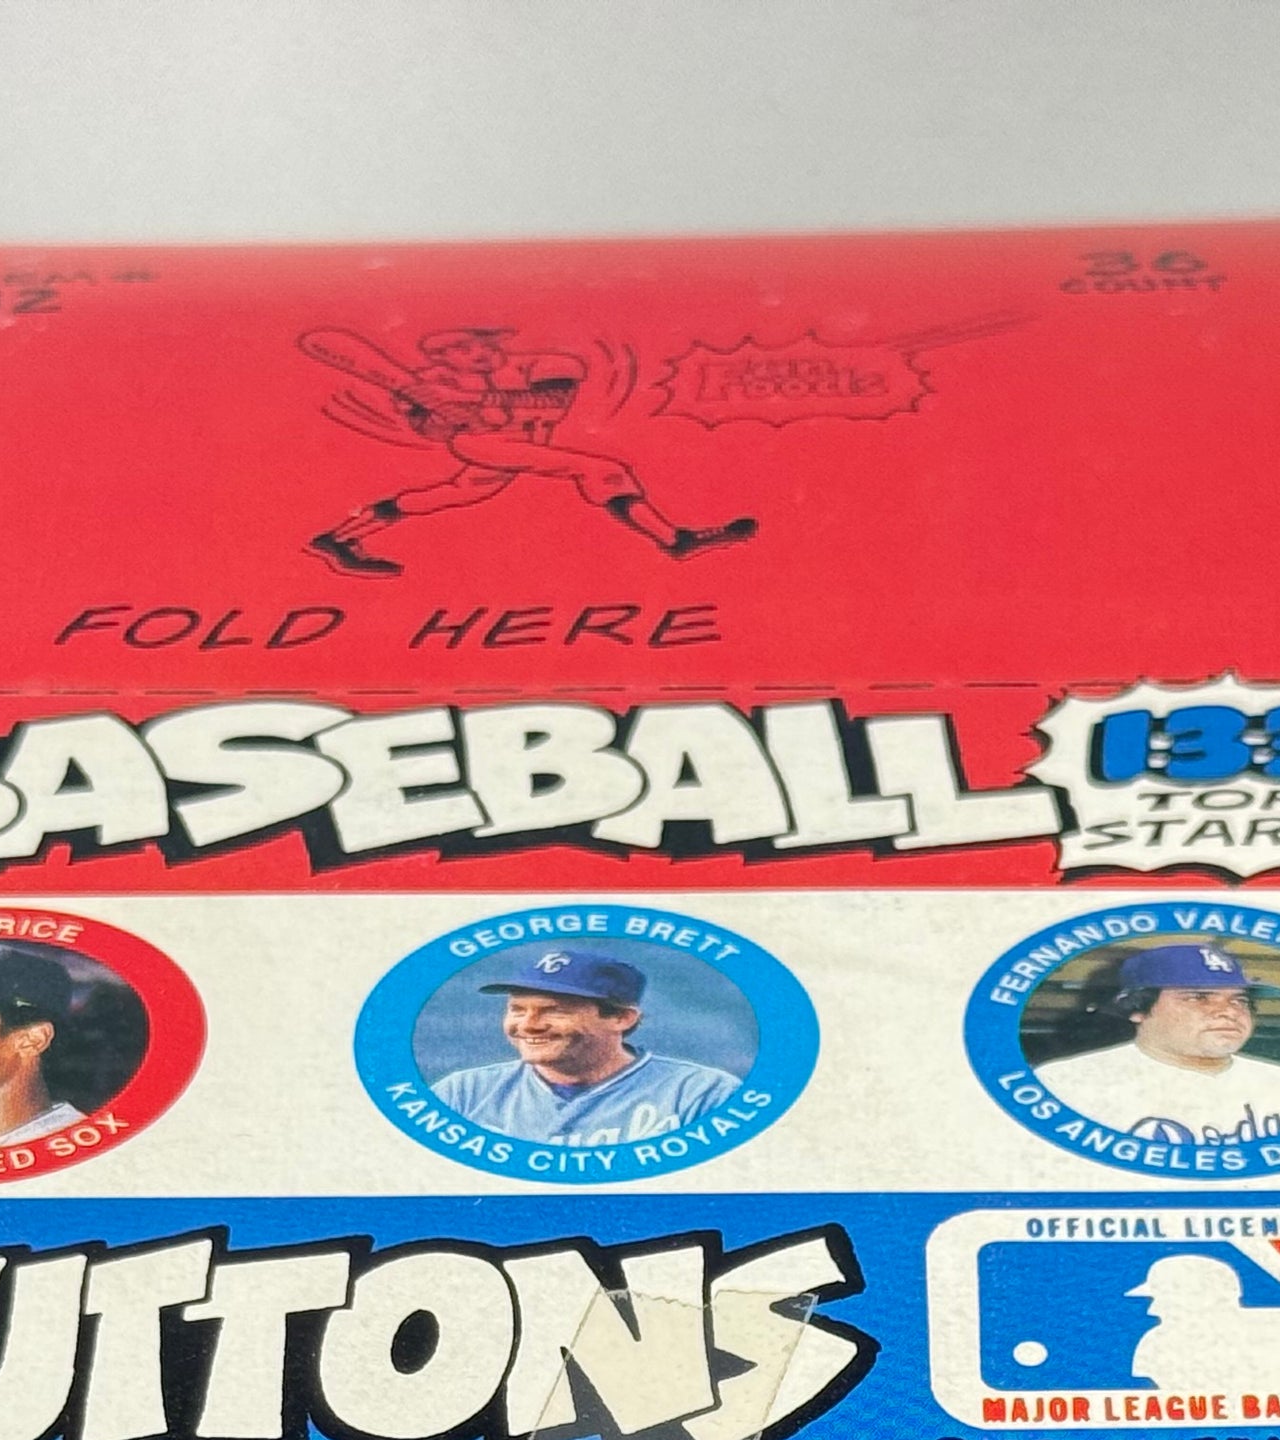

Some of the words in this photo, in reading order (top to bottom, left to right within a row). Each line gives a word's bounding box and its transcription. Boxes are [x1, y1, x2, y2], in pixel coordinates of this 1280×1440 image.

[1058, 273, 1228, 294] COUNT
[1080, 249, 1207, 277] 36
[54, 606, 346, 650] FOLD
[409, 604, 721, 650] HERE
[448, 913, 609, 959] GEORGE
[624, 915, 741, 962] BRETT
[991, 910, 1158, 1007] FERNANDO
[47, 1112, 130, 1159] SOX
[385, 1080, 514, 1166] KANSAS
[528, 1150, 617, 1173] CITY
[636, 1088, 772, 1167] ROYALS
[998, 1069, 1061, 1121] LOS
[1058, 1118, 1247, 1172] ANGELES
[1025, 1215, 1166, 1238] OFFICIAL
[981, 1396, 1092, 1424] MAJOR
[1104, 1393, 1225, 1421] LEAGUE
